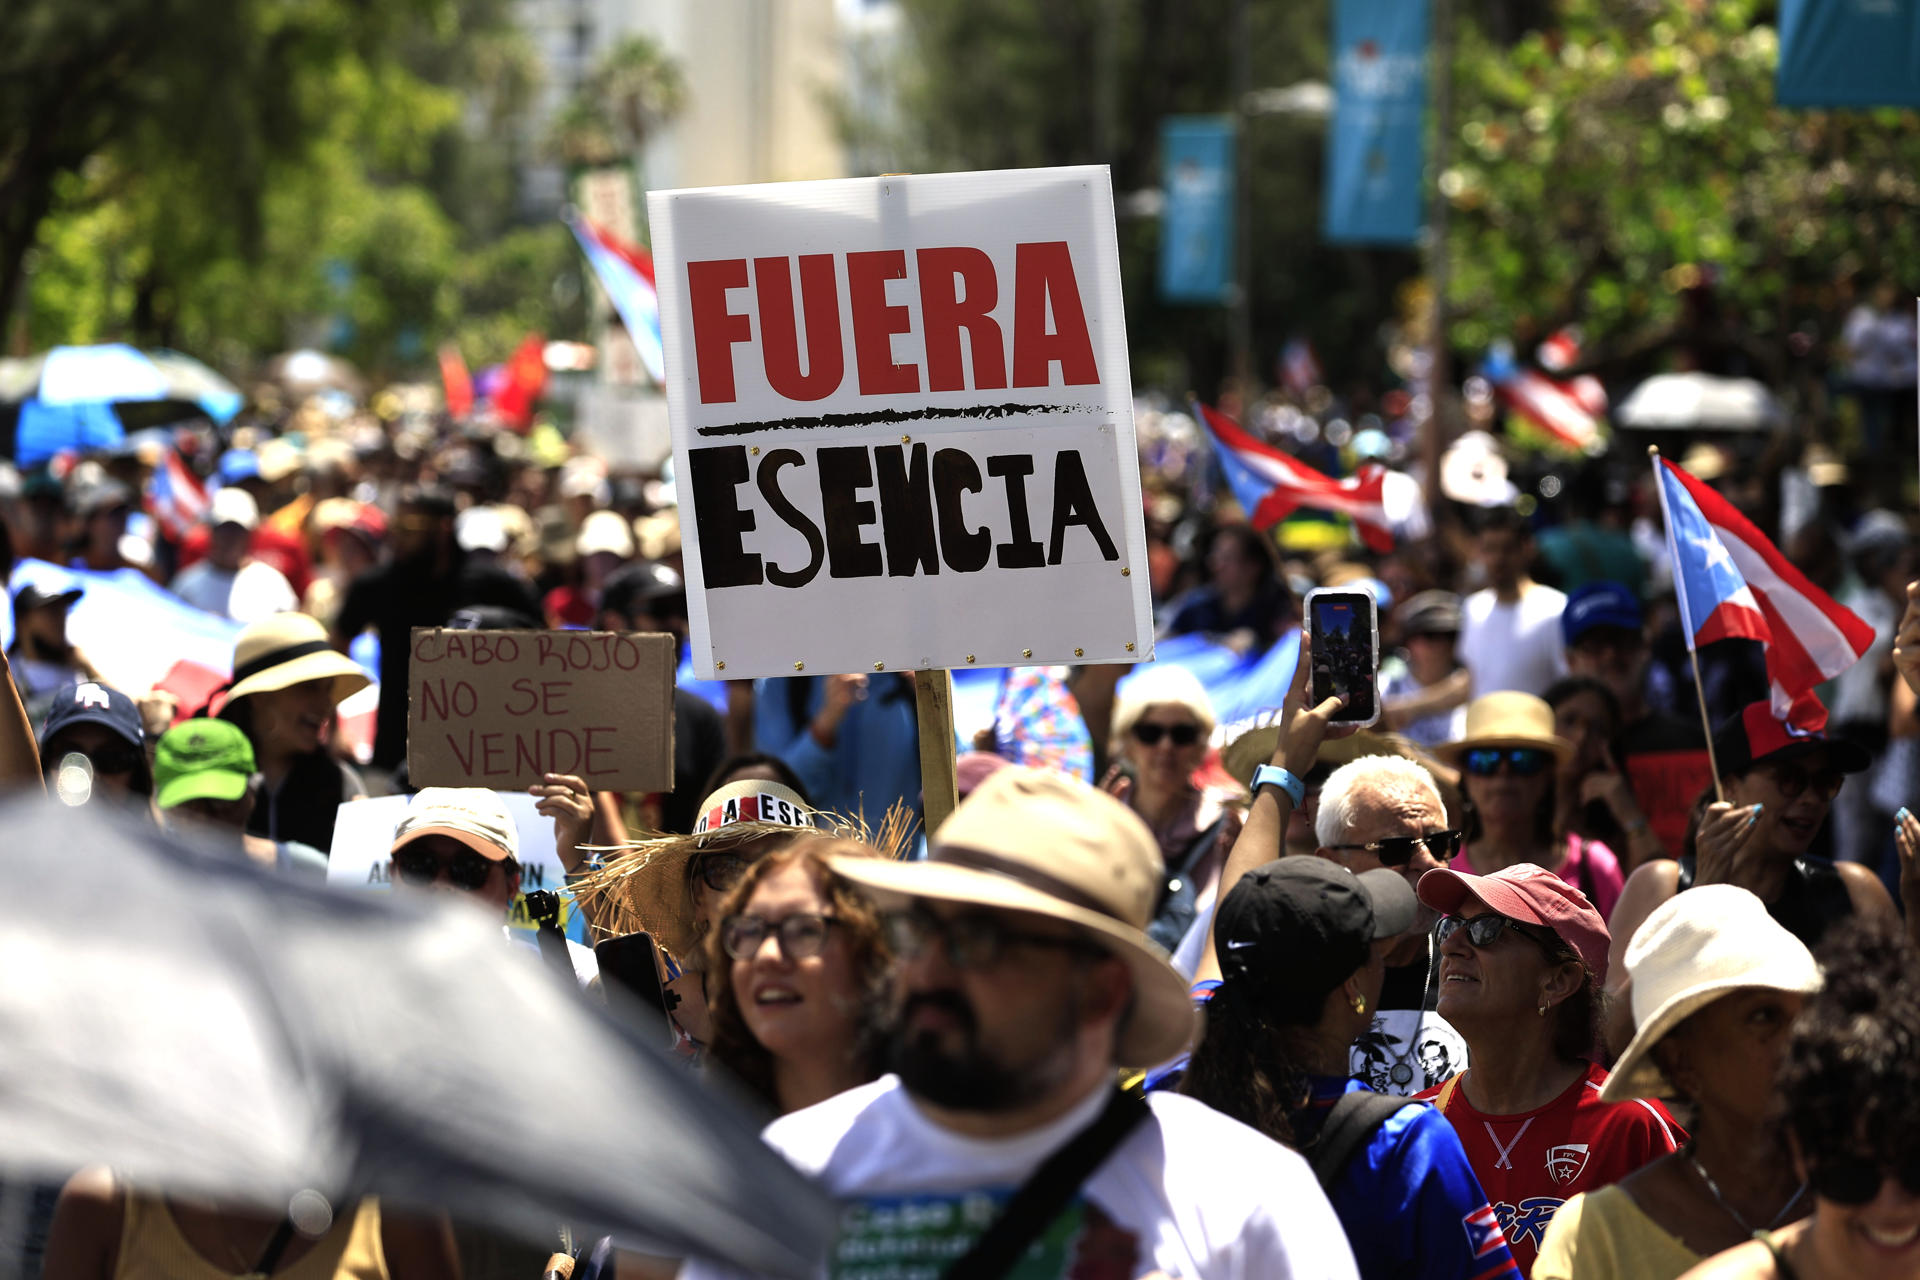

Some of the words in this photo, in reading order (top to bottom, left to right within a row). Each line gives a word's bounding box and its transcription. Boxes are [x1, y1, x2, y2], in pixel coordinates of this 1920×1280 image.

[687, 241, 1100, 404] FUERA
[688, 442, 1119, 589] ESENCIA
[414, 634, 519, 664] CABO
[535, 634, 641, 672] ROJO
[420, 678, 478, 722] NO
[504, 678, 573, 716] SE
[446, 727, 620, 777] VENDE
[724, 798, 738, 823] A
